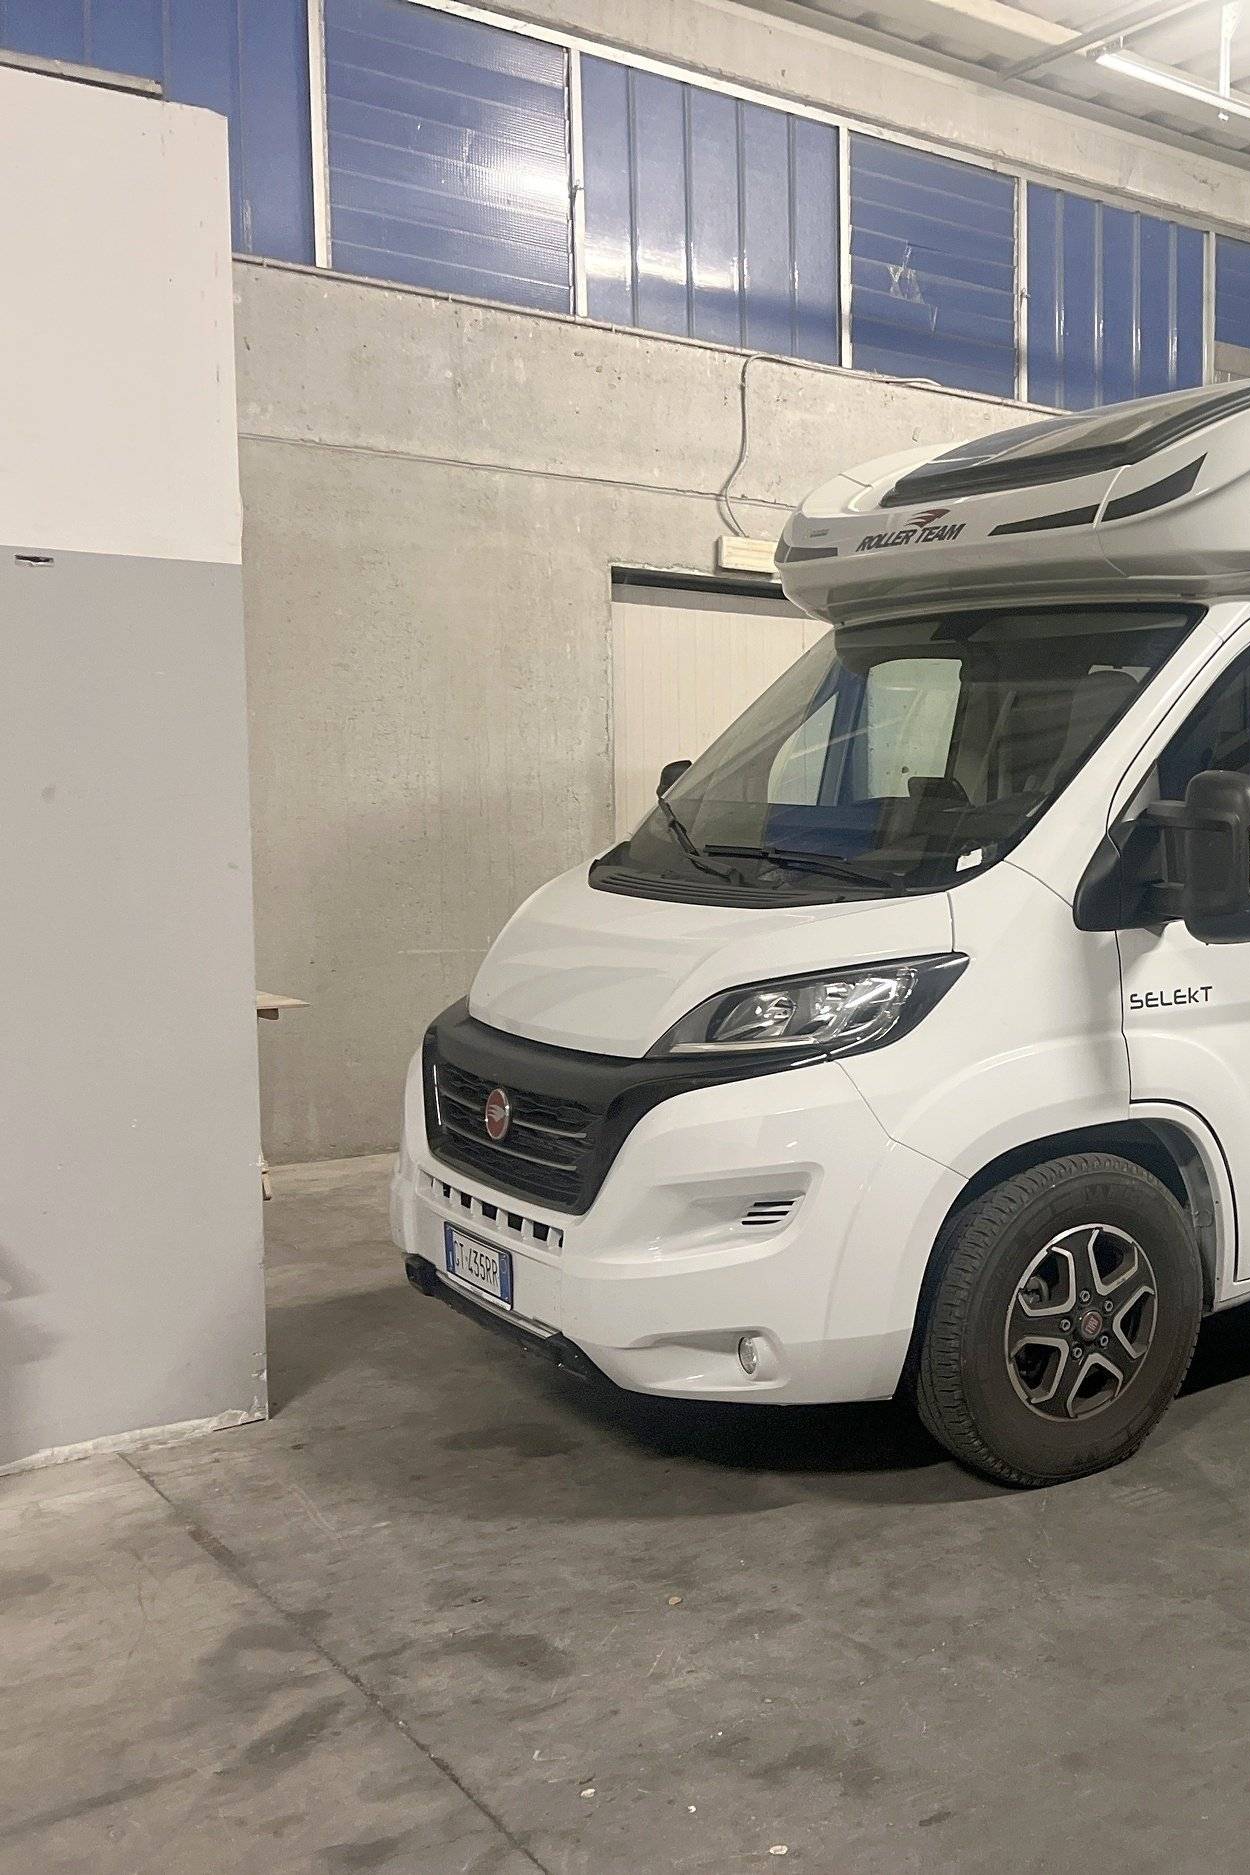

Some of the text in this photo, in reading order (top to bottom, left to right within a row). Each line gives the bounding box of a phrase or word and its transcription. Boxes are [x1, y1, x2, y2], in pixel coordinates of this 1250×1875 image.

[855, 528, 918, 553] ROLLER
[914, 523, 967, 544] TEAM
[1129, 985, 1213, 1010] SELEKT
